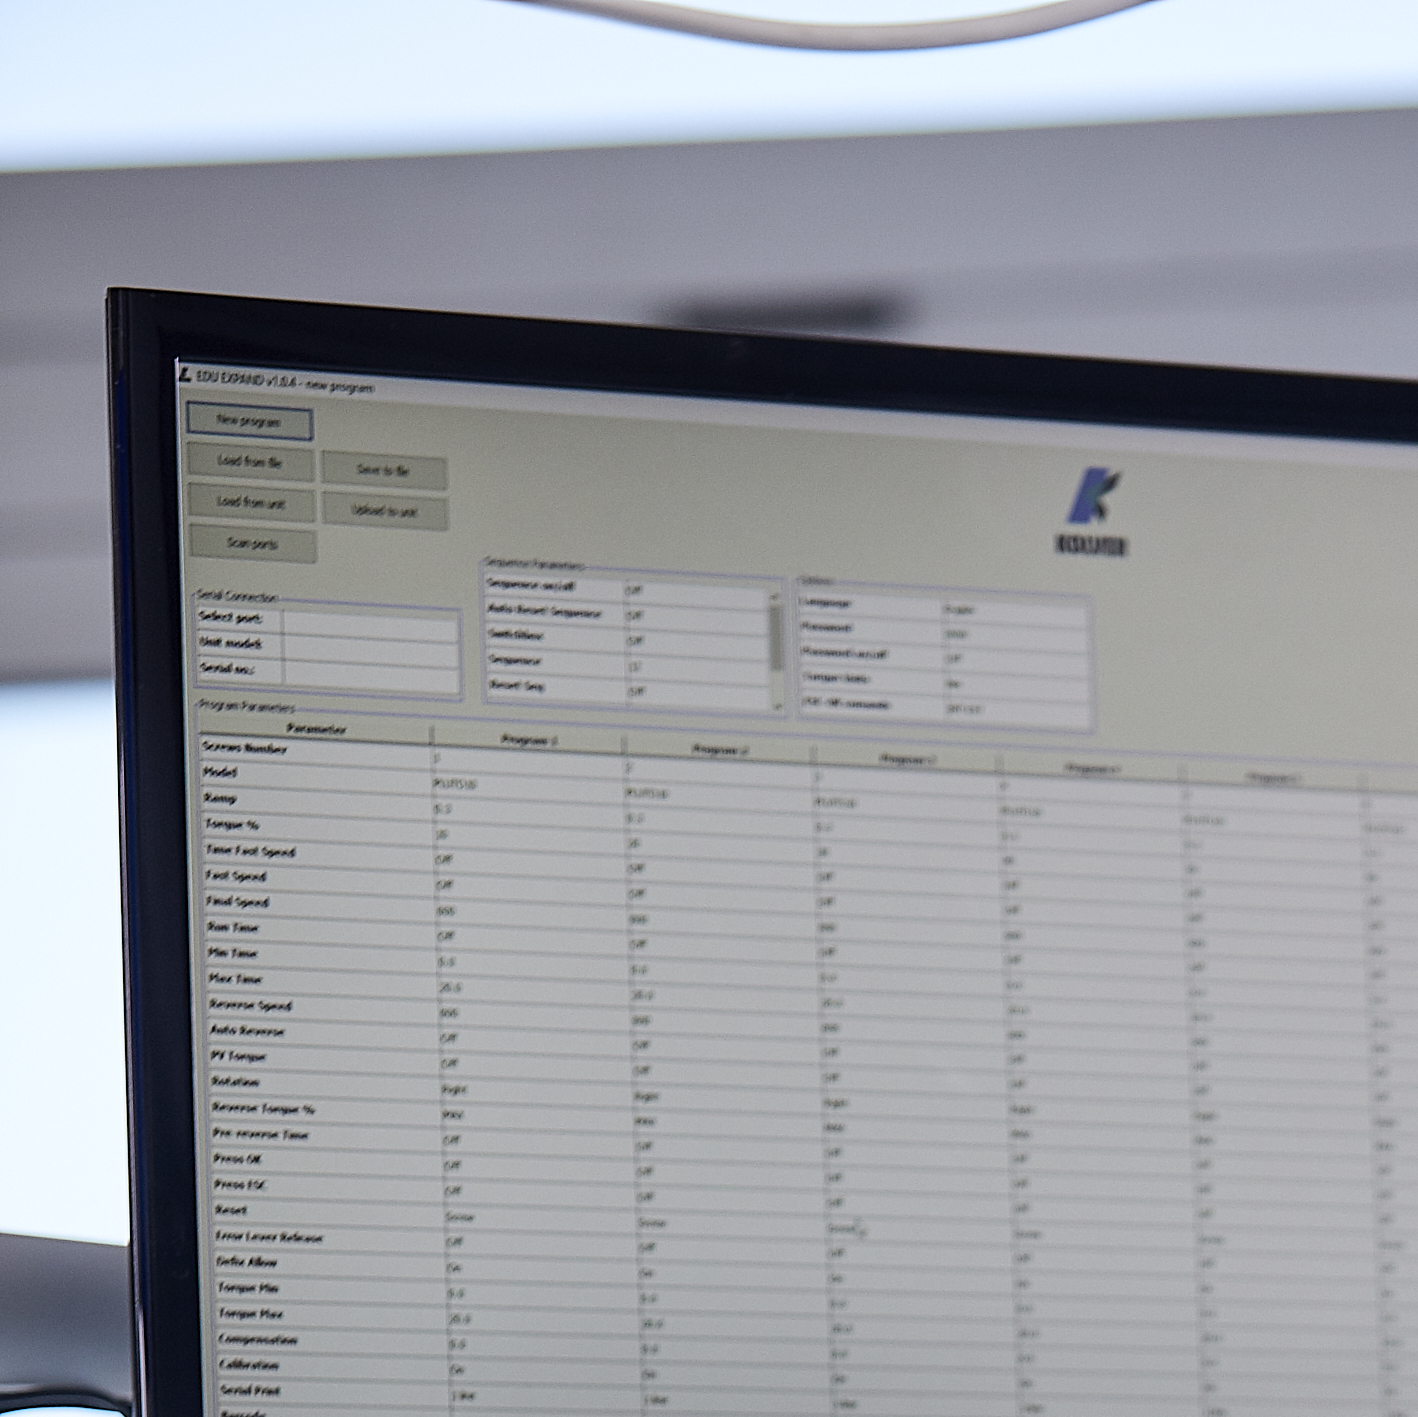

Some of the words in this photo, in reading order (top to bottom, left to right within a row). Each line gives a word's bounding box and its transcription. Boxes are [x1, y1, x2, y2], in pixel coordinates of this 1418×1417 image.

[217, 454, 241, 467] Load
[243, 456, 263, 468] from
[217, 495, 241, 508] Load
[243, 497, 264, 510] from
